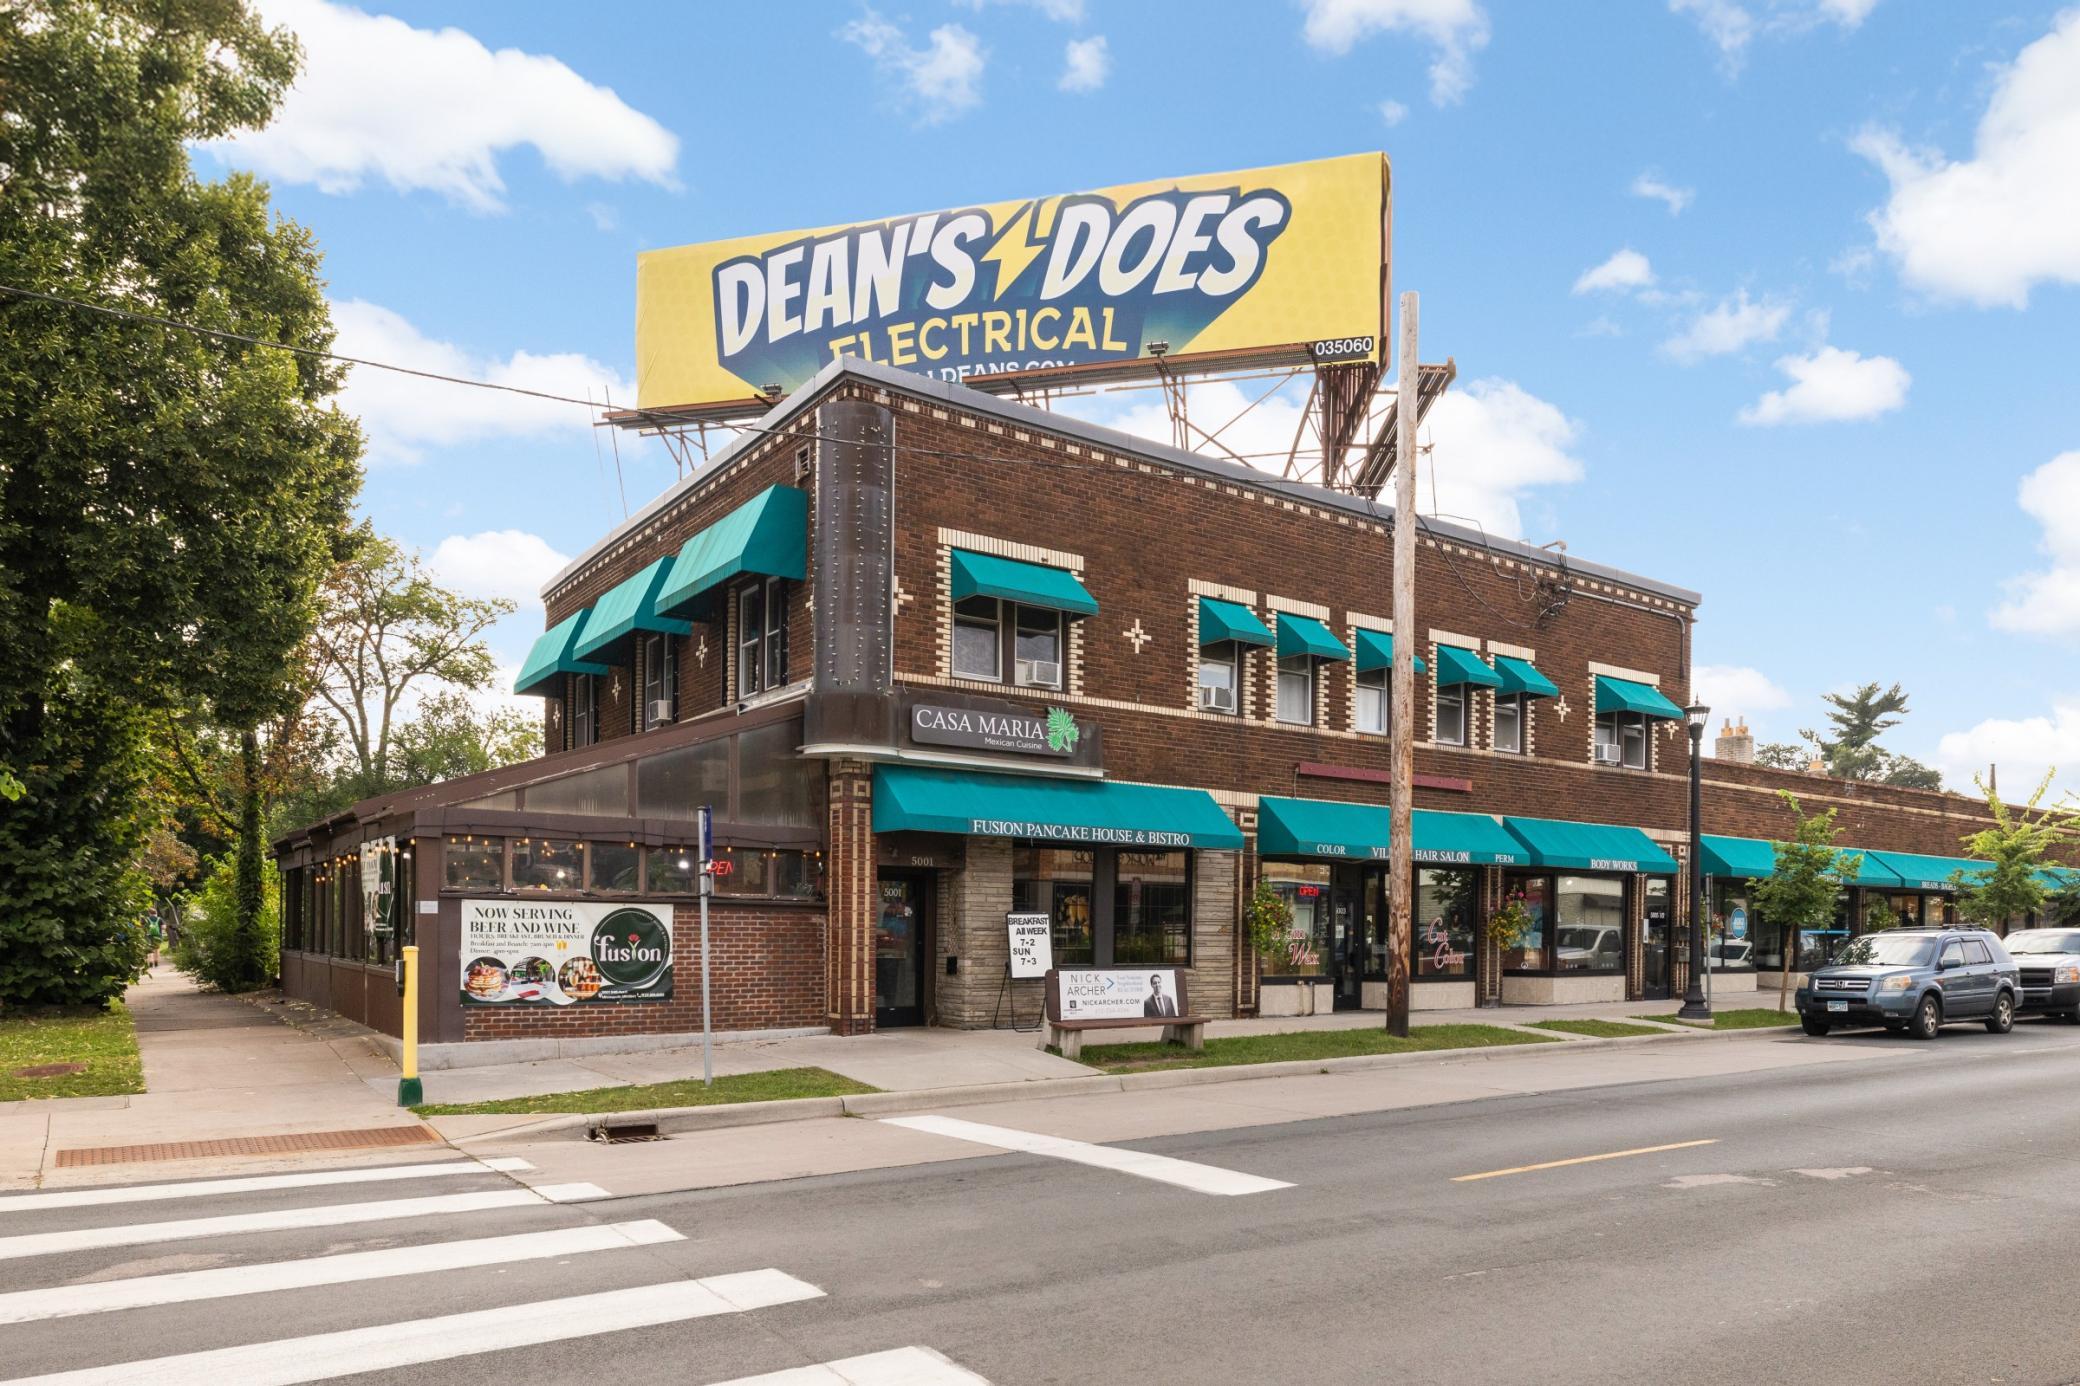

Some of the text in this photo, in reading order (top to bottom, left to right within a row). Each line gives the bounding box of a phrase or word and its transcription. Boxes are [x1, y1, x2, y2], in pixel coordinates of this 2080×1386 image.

[718, 194, 1285, 357] DEAN'S DOES
[1315, 337, 1373, 356] 035060
[916, 709, 1045, 740] CASA MARIA
[984, 737, 1043, 750] Mexican Cuisine
[973, 819, 1190, 846] FUSION PANCAKE HOUSE & BISTRO
[1316, 843, 1346, 856] COLOR
[1415, 849, 1438, 861] HAIR
[1439, 851, 1470, 862] SALON
[911, 856, 934, 866] 5001
[1494, 853, 1514, 864] PERM
[1590, 858, 1637, 871] BODY WORKS
[708, 861, 734, 875] PEN
[884, 887, 902, 897] 5001
[475, 907, 572, 920] NOW SERVING
[470, 921, 580, 934] BEER AND WINE
[1008, 917, 1048, 925] BREAKFAST
[1026, 927, 1047, 935] WEEK
[1428, 916, 1448, 944] Cut
[594, 934, 661, 962] fusion
[1020, 938, 1035, 946] 7-2
[1012, 947, 1030, 955] SUN
[1288, 941, 1320, 966] Wax
[1434, 942, 1464, 969] Color
[1020, 957, 1037, 965] 7-3
[1070, 974, 1100, 983] NICK
[1067, 985, 1106, 996] ARCHER
[1082, 998, 1140, 1006] NICKARCHER.COM
